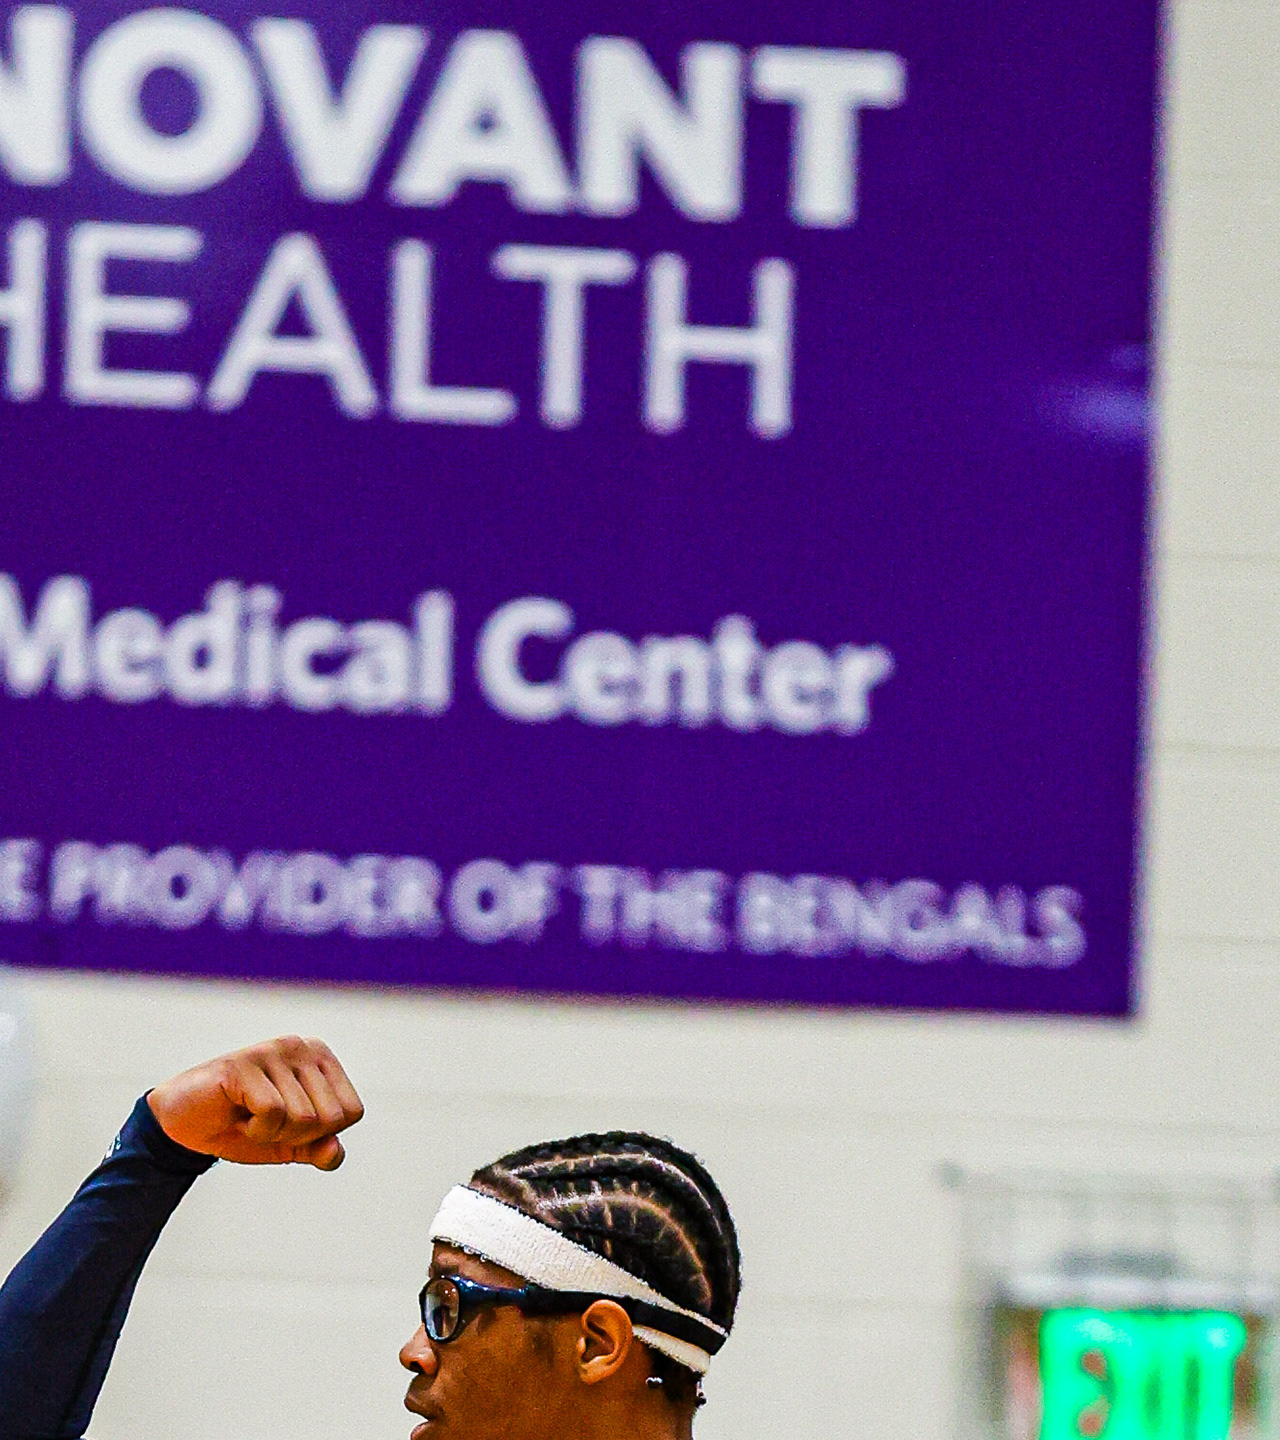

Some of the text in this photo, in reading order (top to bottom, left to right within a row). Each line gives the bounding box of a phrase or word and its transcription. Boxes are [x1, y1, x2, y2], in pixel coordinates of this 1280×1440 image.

[479, 598, 889, 731] Center
[51, 842, 440, 935] PROVIDER
[451, 860, 558, 941] OF
[578, 865, 723, 949] THE
[739, 873, 1084, 962] BENGALS
